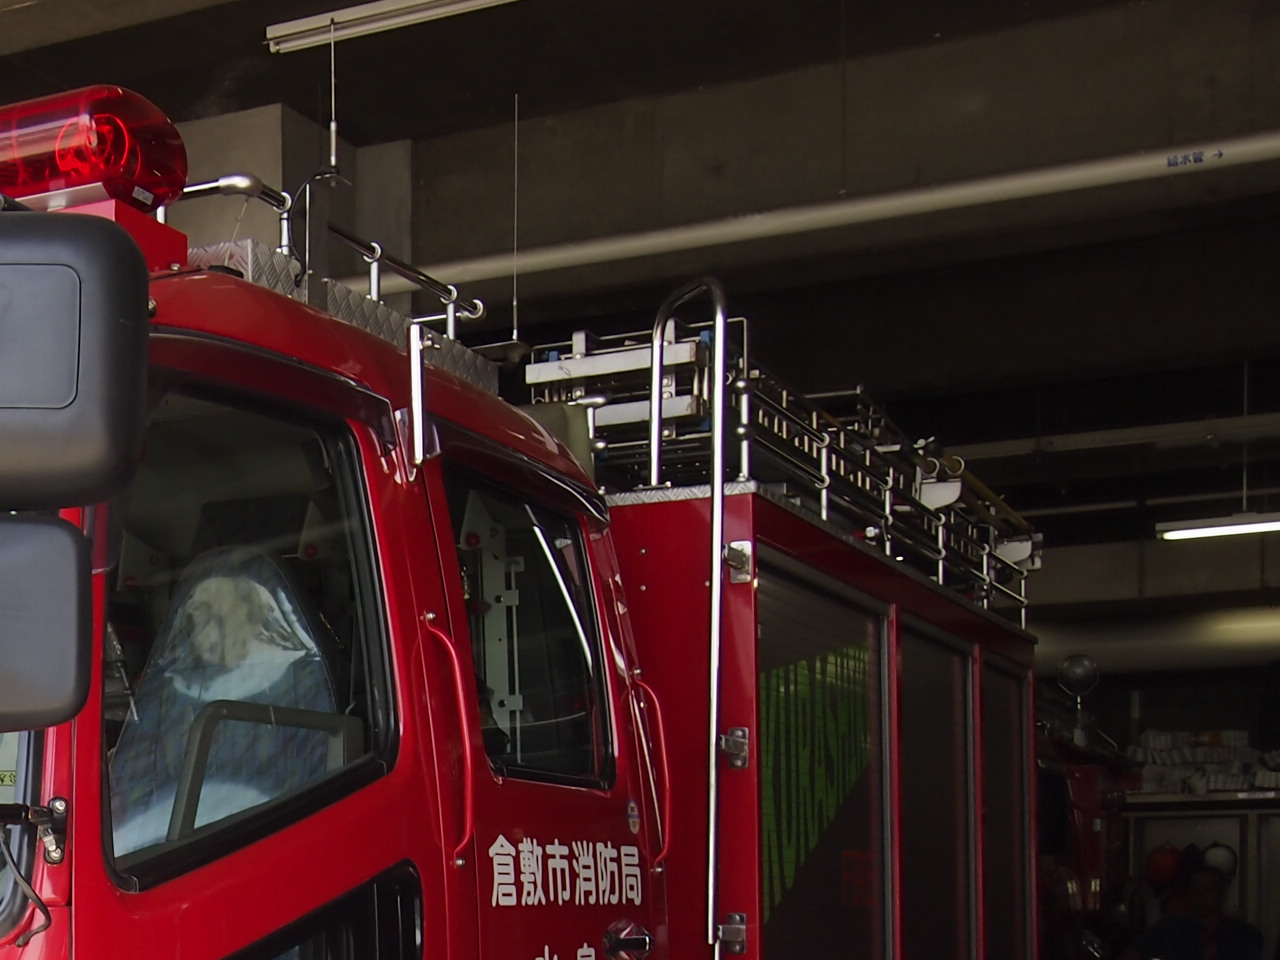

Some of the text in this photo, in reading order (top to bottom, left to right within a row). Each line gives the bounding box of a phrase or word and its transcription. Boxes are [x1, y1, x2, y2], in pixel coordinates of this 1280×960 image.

[488, 834, 642, 907] 倉敷市消防局
